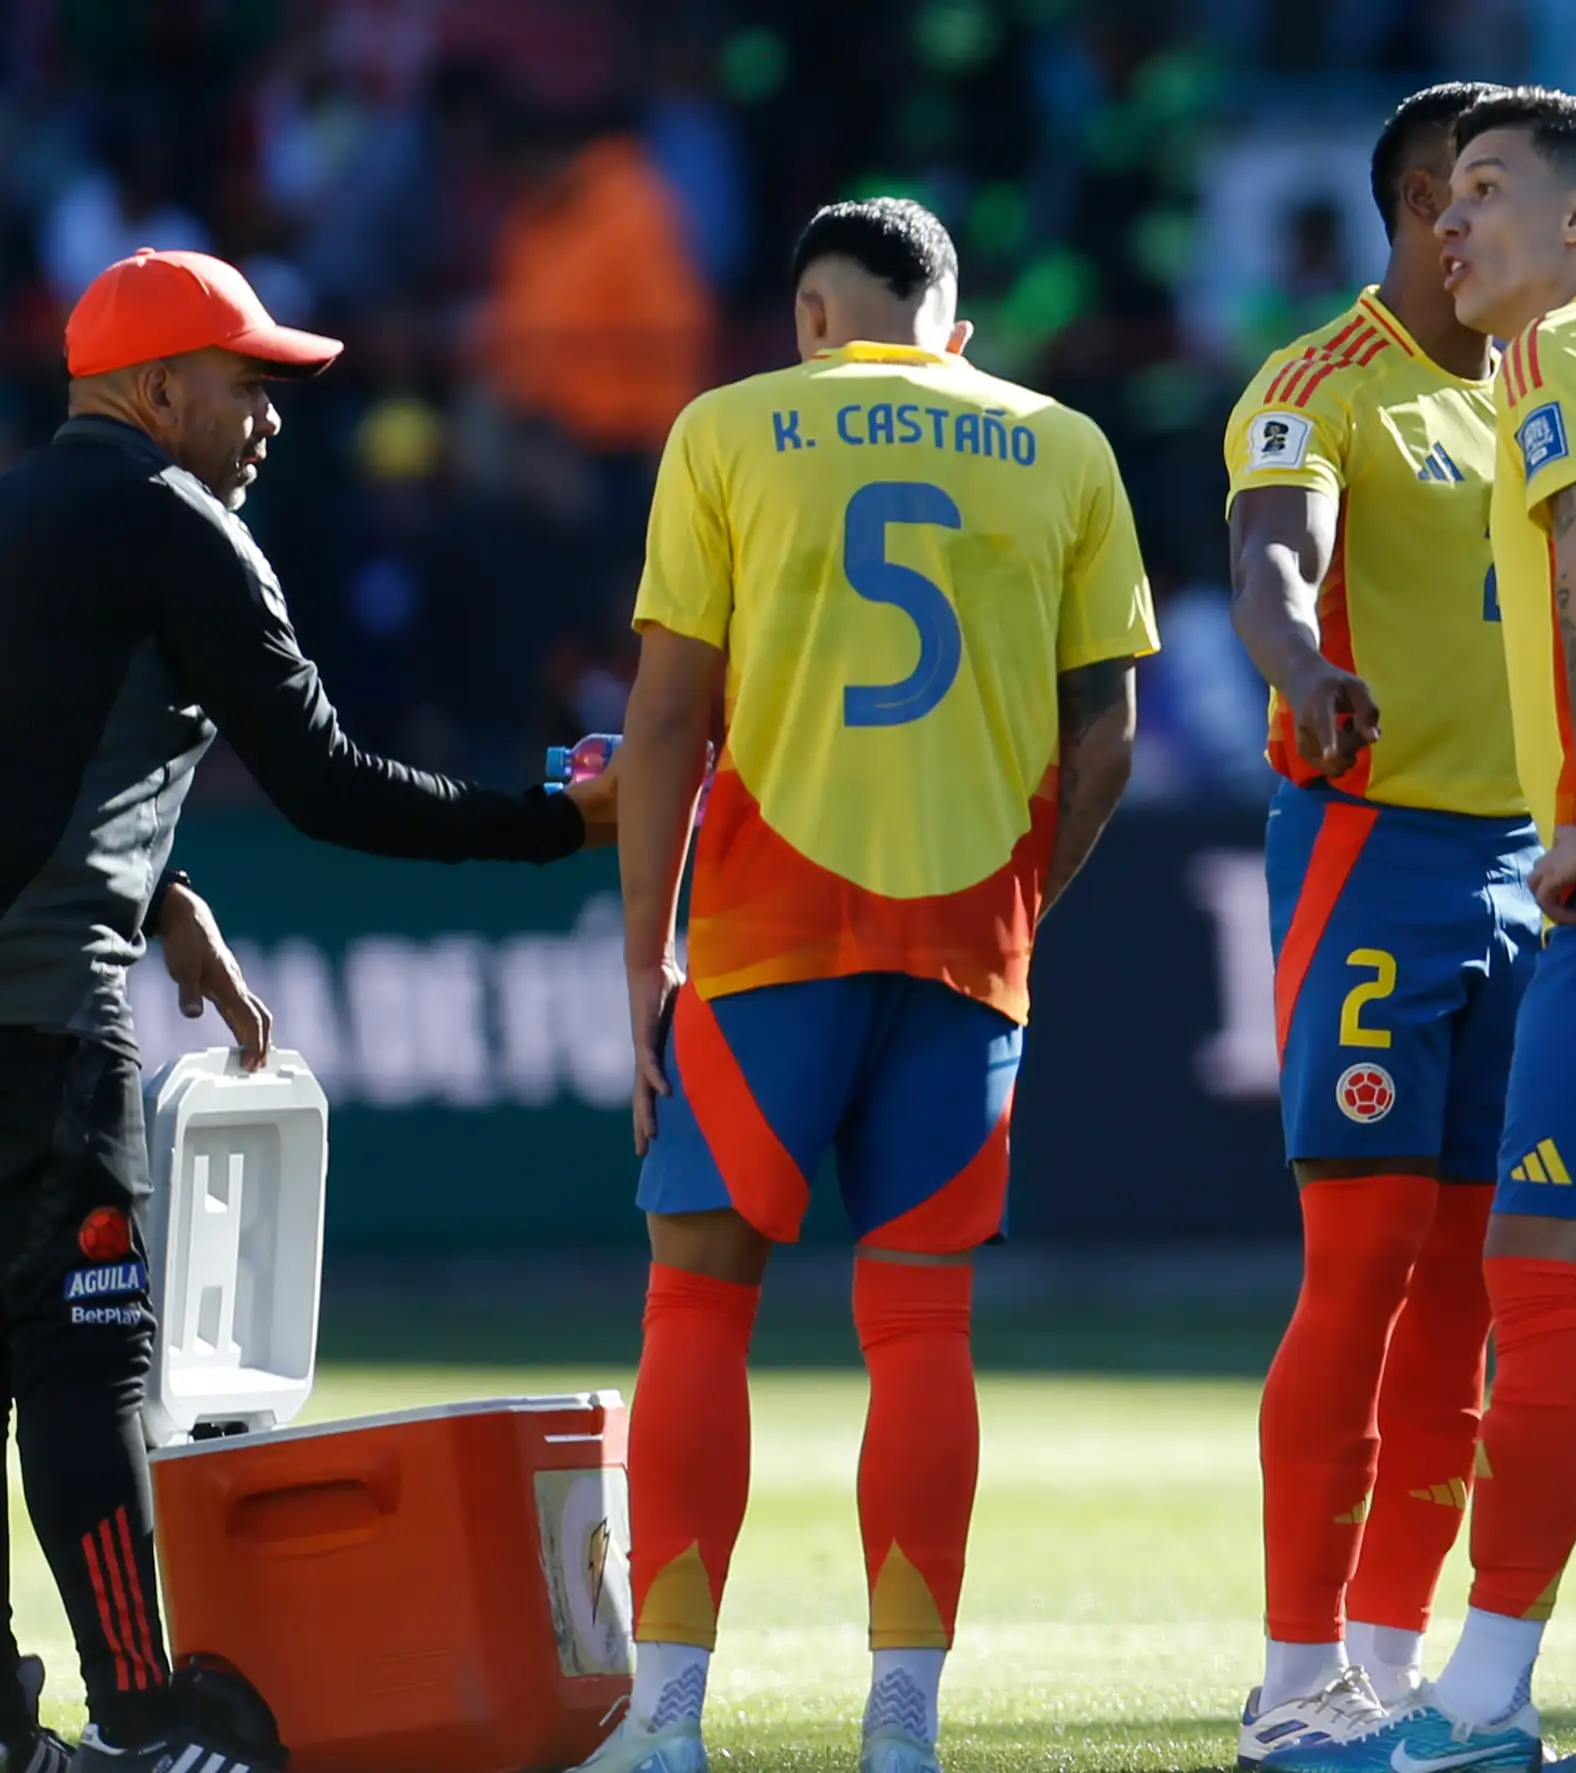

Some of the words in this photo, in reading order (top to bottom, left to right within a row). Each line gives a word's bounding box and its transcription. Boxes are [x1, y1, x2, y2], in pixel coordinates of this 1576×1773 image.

[773, 409, 816, 453] K.
[836, 403, 1037, 467] CASTAÑO
[842, 480, 962, 728] 5
[1338, 947, 1398, 1049] 2
[69, 1264, 140, 1298] AGUILA
[71, 1305, 141, 1326] BetPlay
